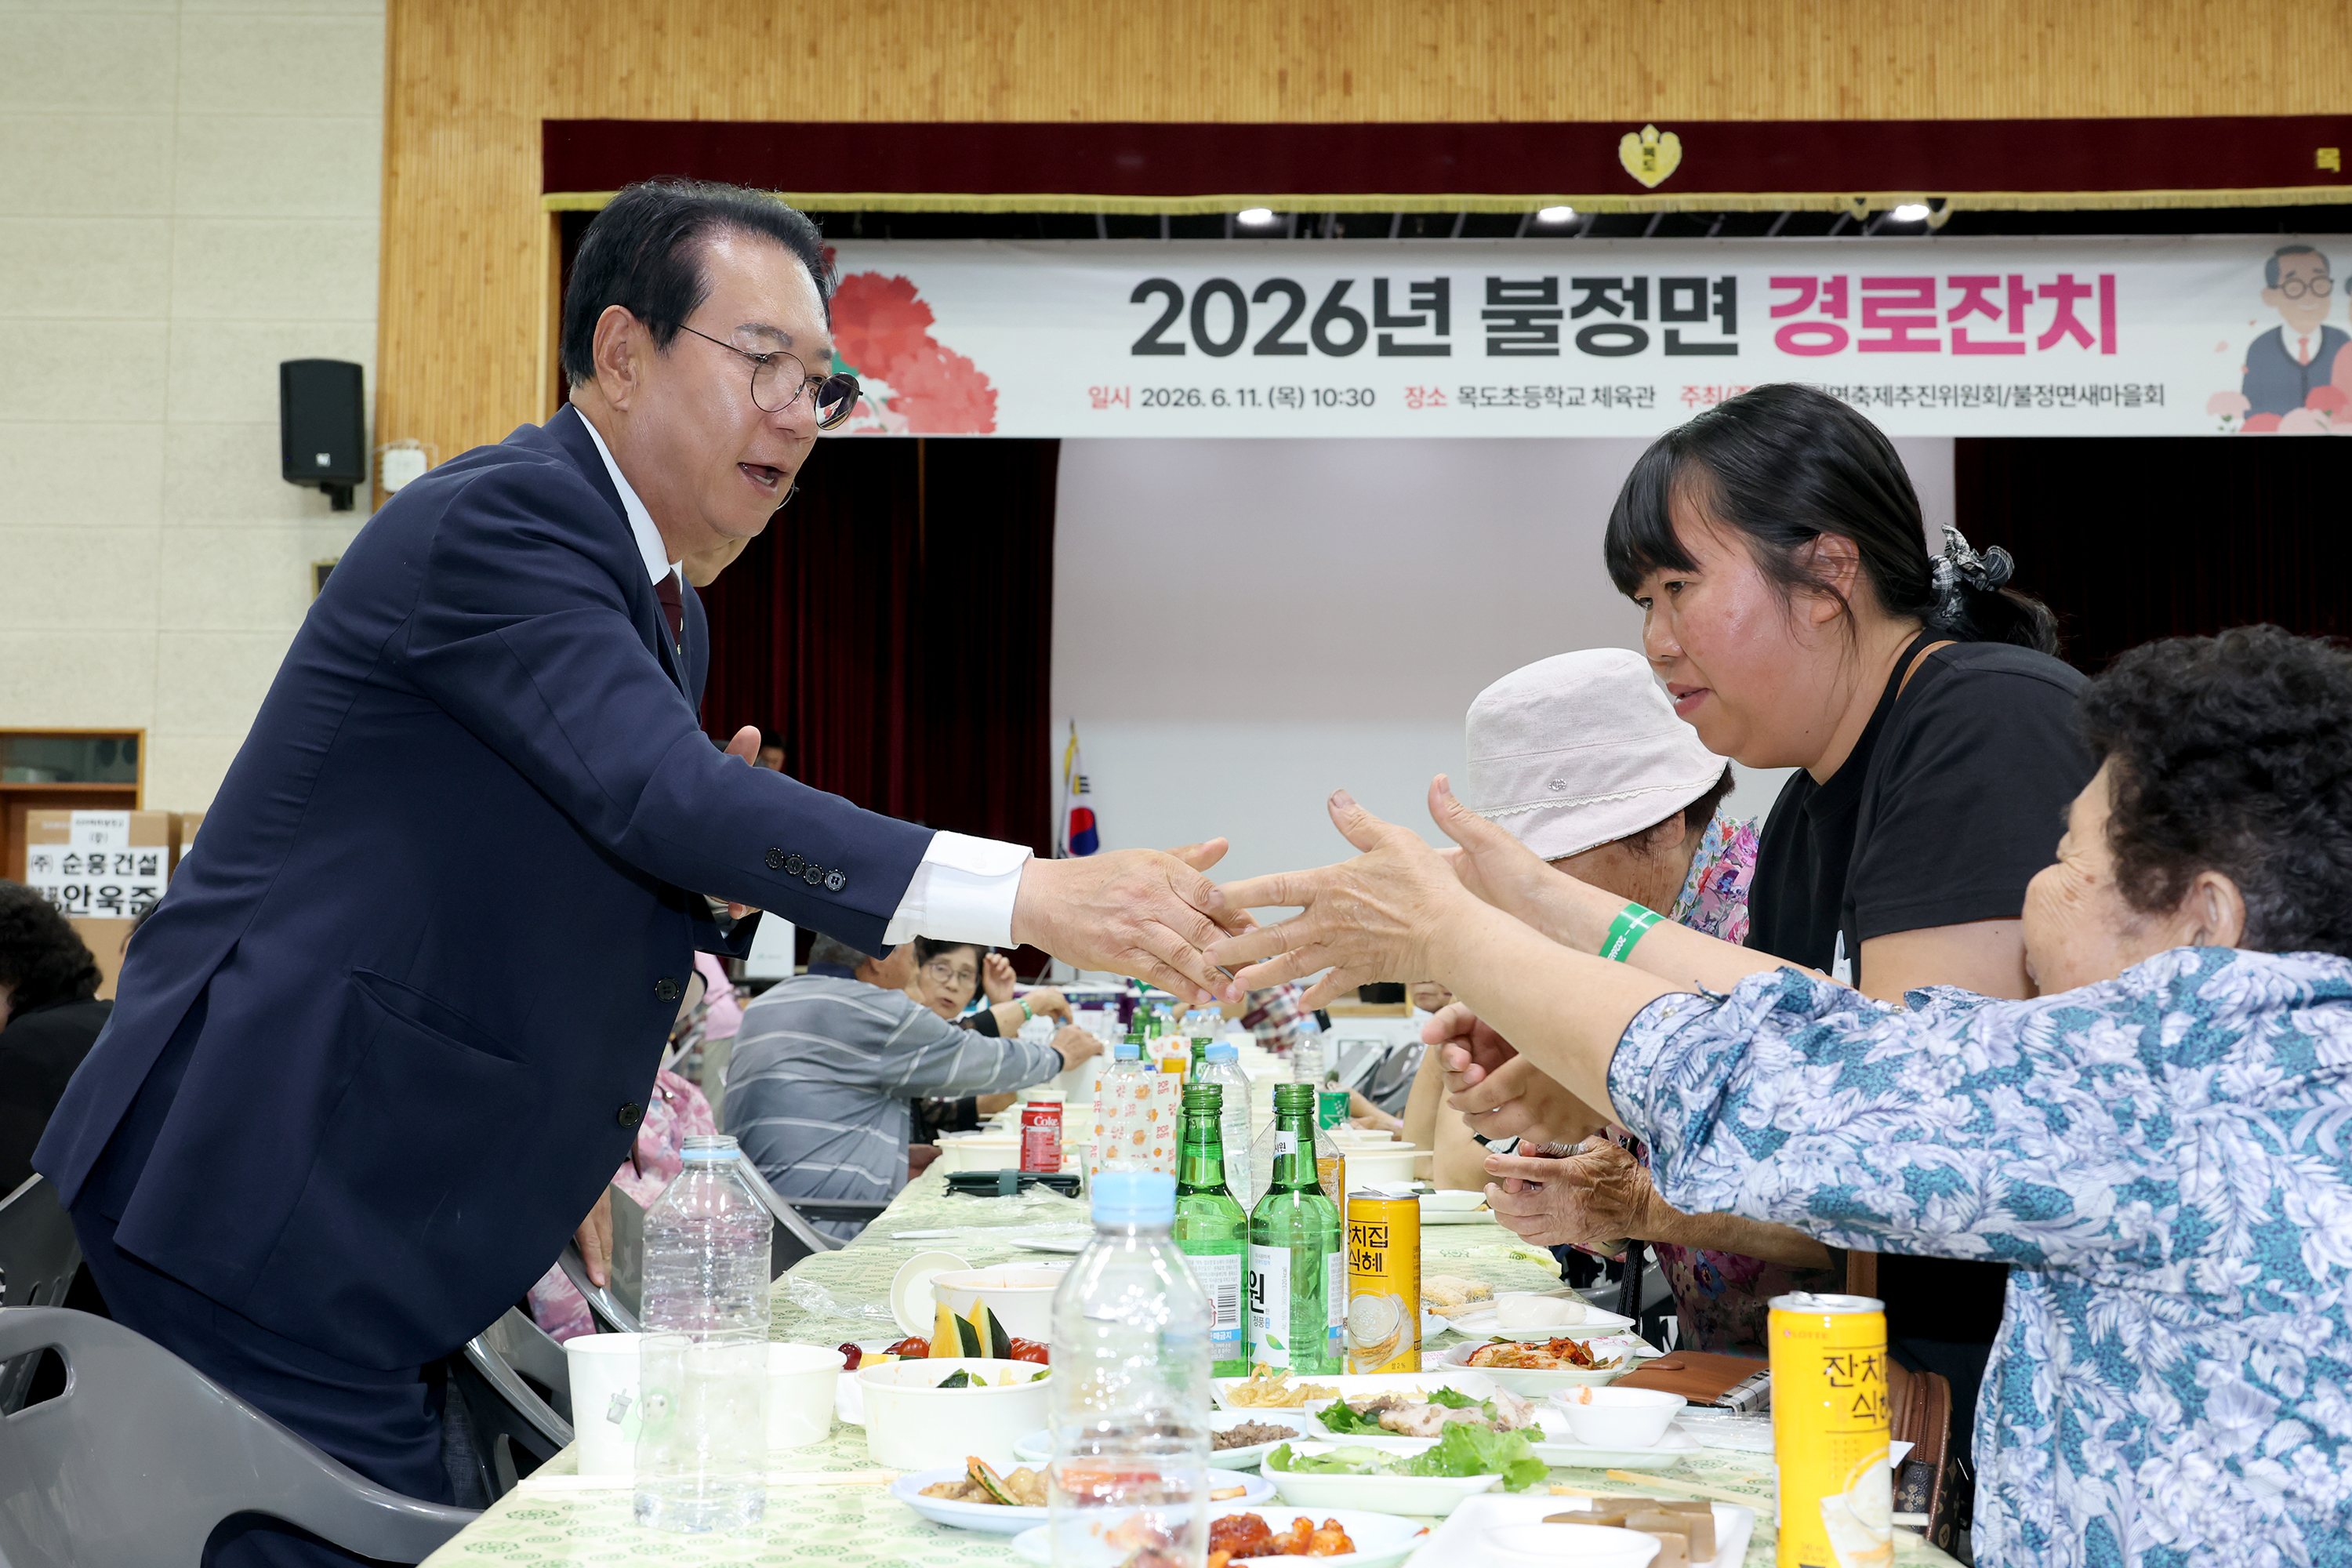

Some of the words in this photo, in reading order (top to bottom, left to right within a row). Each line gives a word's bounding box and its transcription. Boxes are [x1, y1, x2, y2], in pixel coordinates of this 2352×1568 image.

[1130, 277, 1452, 358] 2026년
[1480, 275, 1739, 358] 불정면
[1769, 274, 2117, 357] 경로잔치
[1089, 386, 1131, 409] 일시
[1142, 389, 1206, 408] 2026.
[1211, 389, 1232, 408] 6.
[1239, 389, 1261, 408] 11.
[1269, 386, 1304, 409] (목)
[1313, 389, 1375, 408] 10:30
[1405, 386, 1448, 409] 장소
[1457, 385, 1586, 409] 목도초등학교
[1592, 385, 1656, 409] 체육관
[1825, 383, 2165, 408] 면축제추진위원회/불정면새마을회
[1033, 1116, 1059, 1127] Coke
[1156, 1124, 1169, 1133] POP
[1348, 1224, 1388, 1248] 치집
[1348, 1249, 1382, 1272] 식혜
[1253, 1316, 1265, 1328] 청풍
